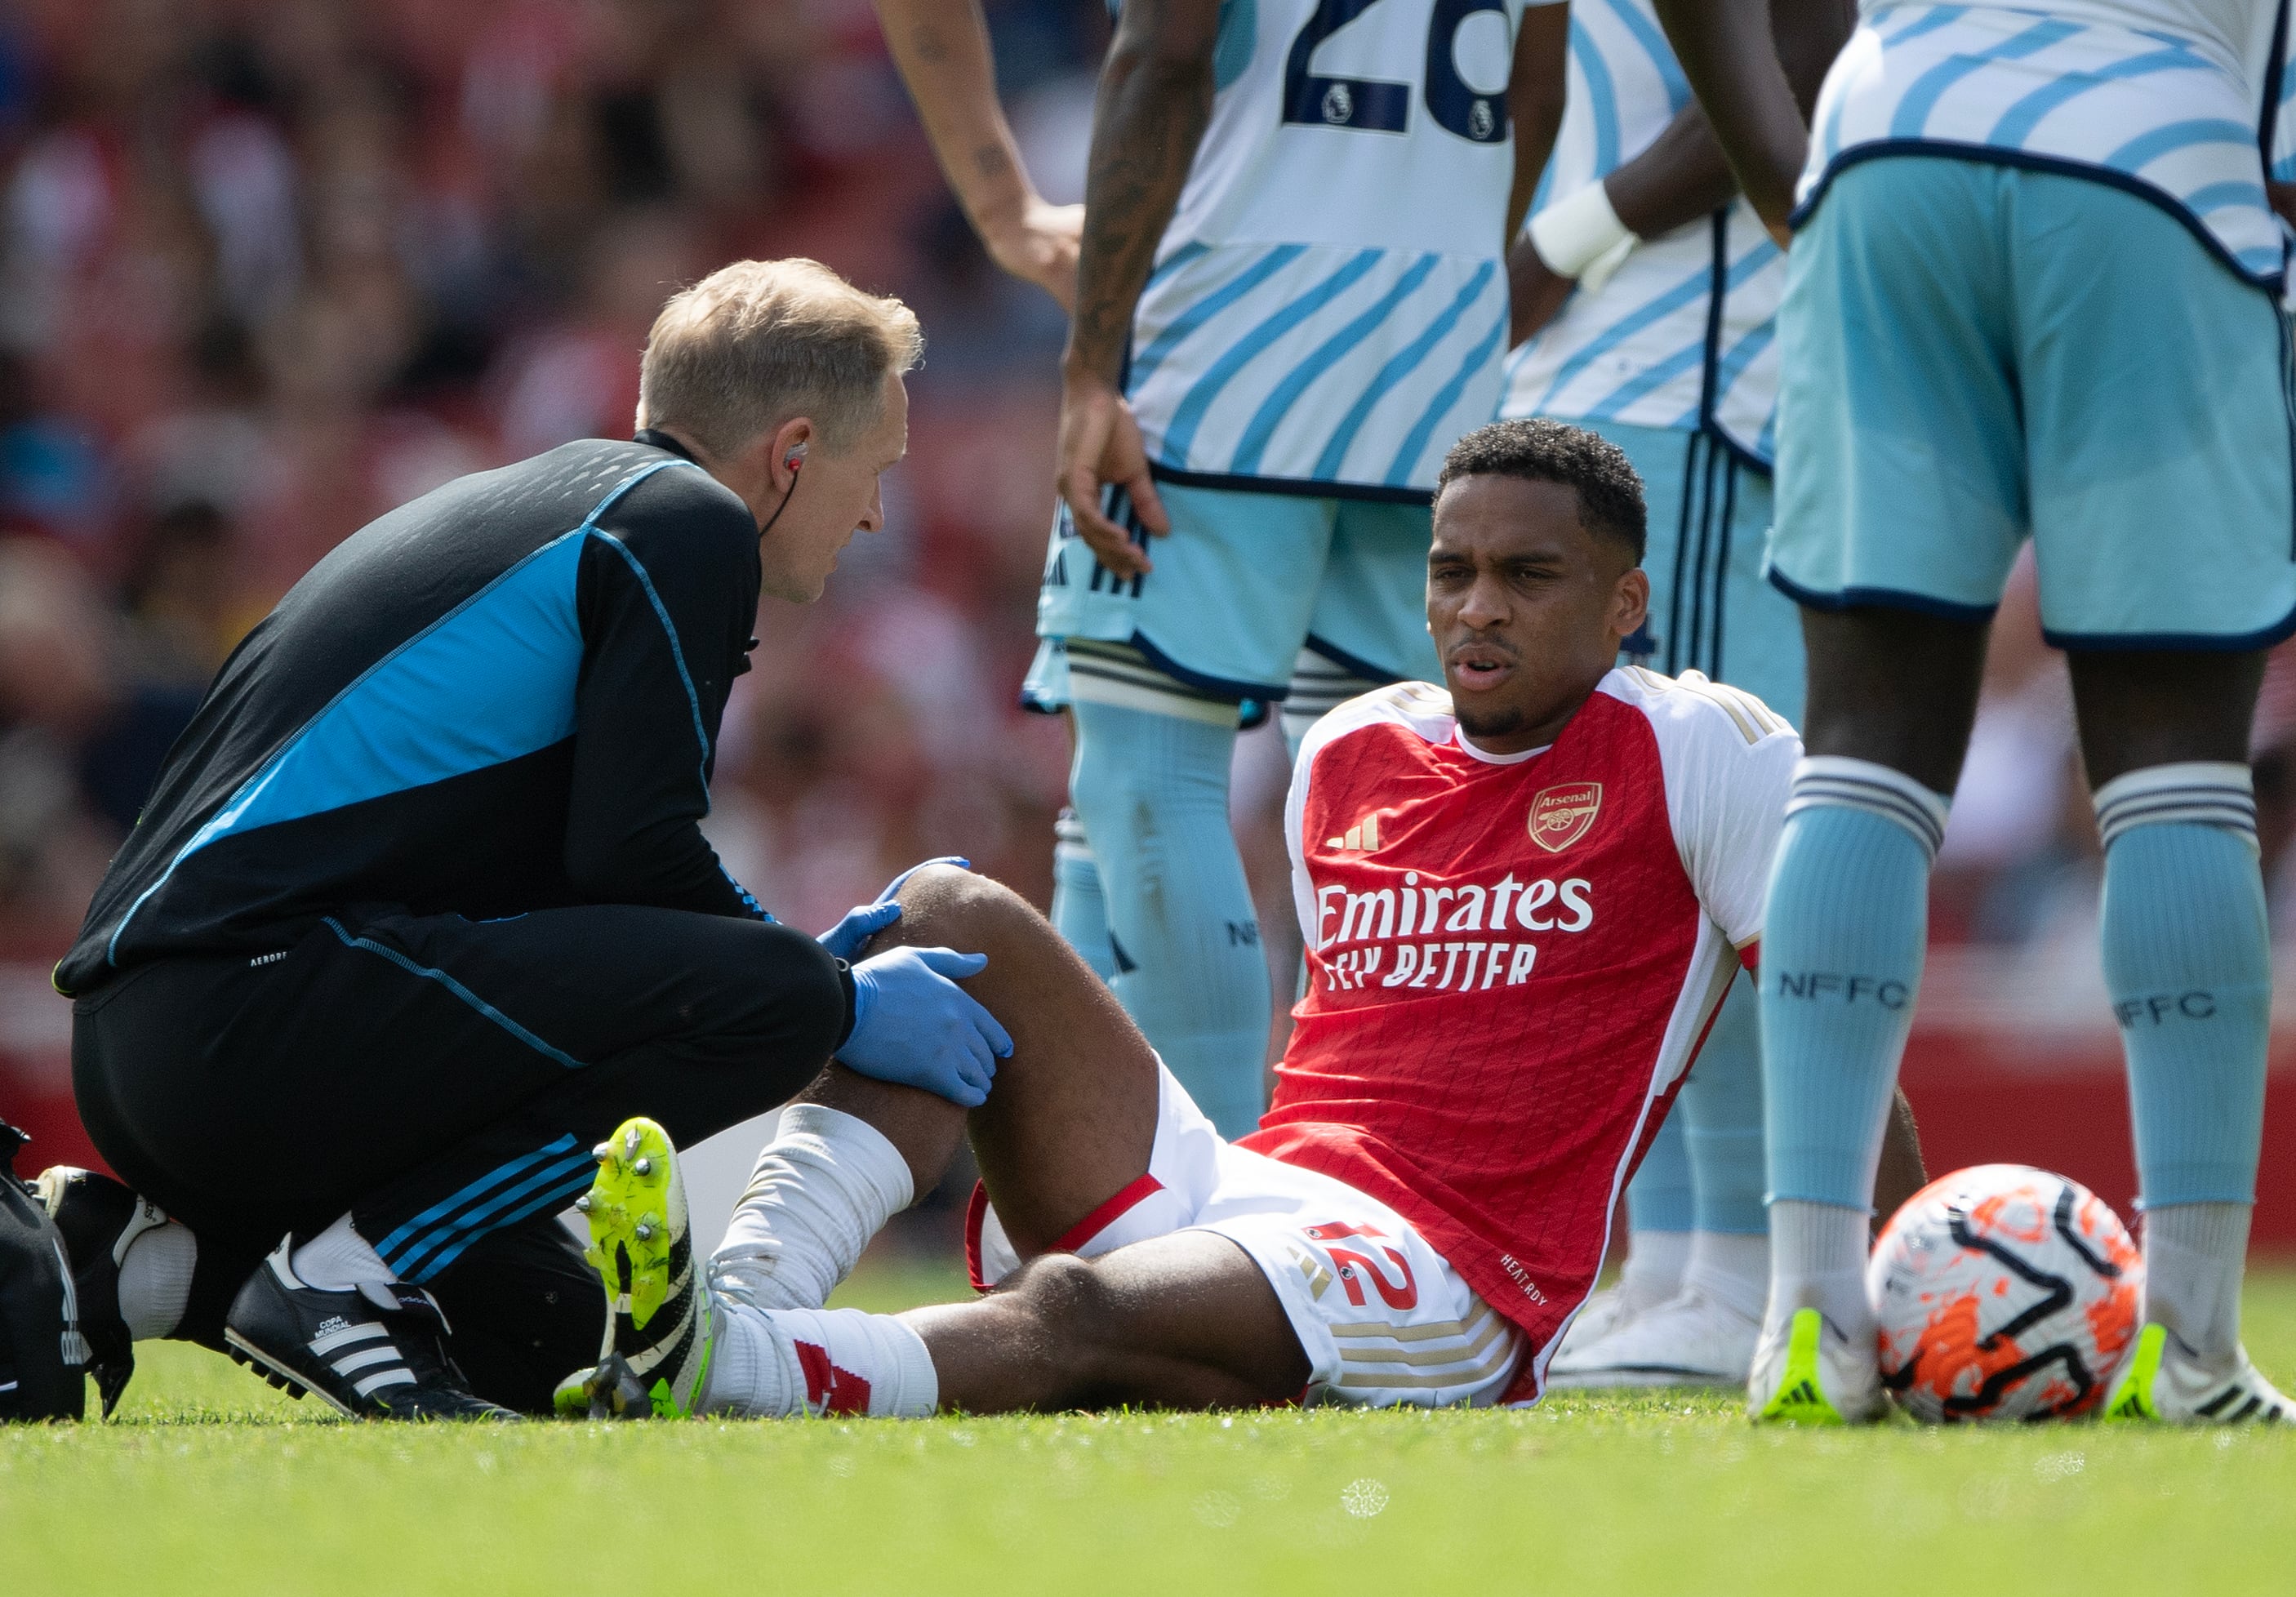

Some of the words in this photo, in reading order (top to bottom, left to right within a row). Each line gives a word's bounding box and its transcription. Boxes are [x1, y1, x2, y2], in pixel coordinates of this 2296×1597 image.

[1540, 790, 1591, 808] Arsenal
[1317, 871, 1594, 953] Emirates
[1382, 942, 1537, 992] BETTER
[1778, 972, 1908, 1010] NFFC
[1301, 1221, 1419, 1312] 12
[1500, 1253, 1548, 1306] HEAT.RDY
[314, 1320, 352, 1340] MUNDIAL
[319, 1315, 343, 1329] COPA
